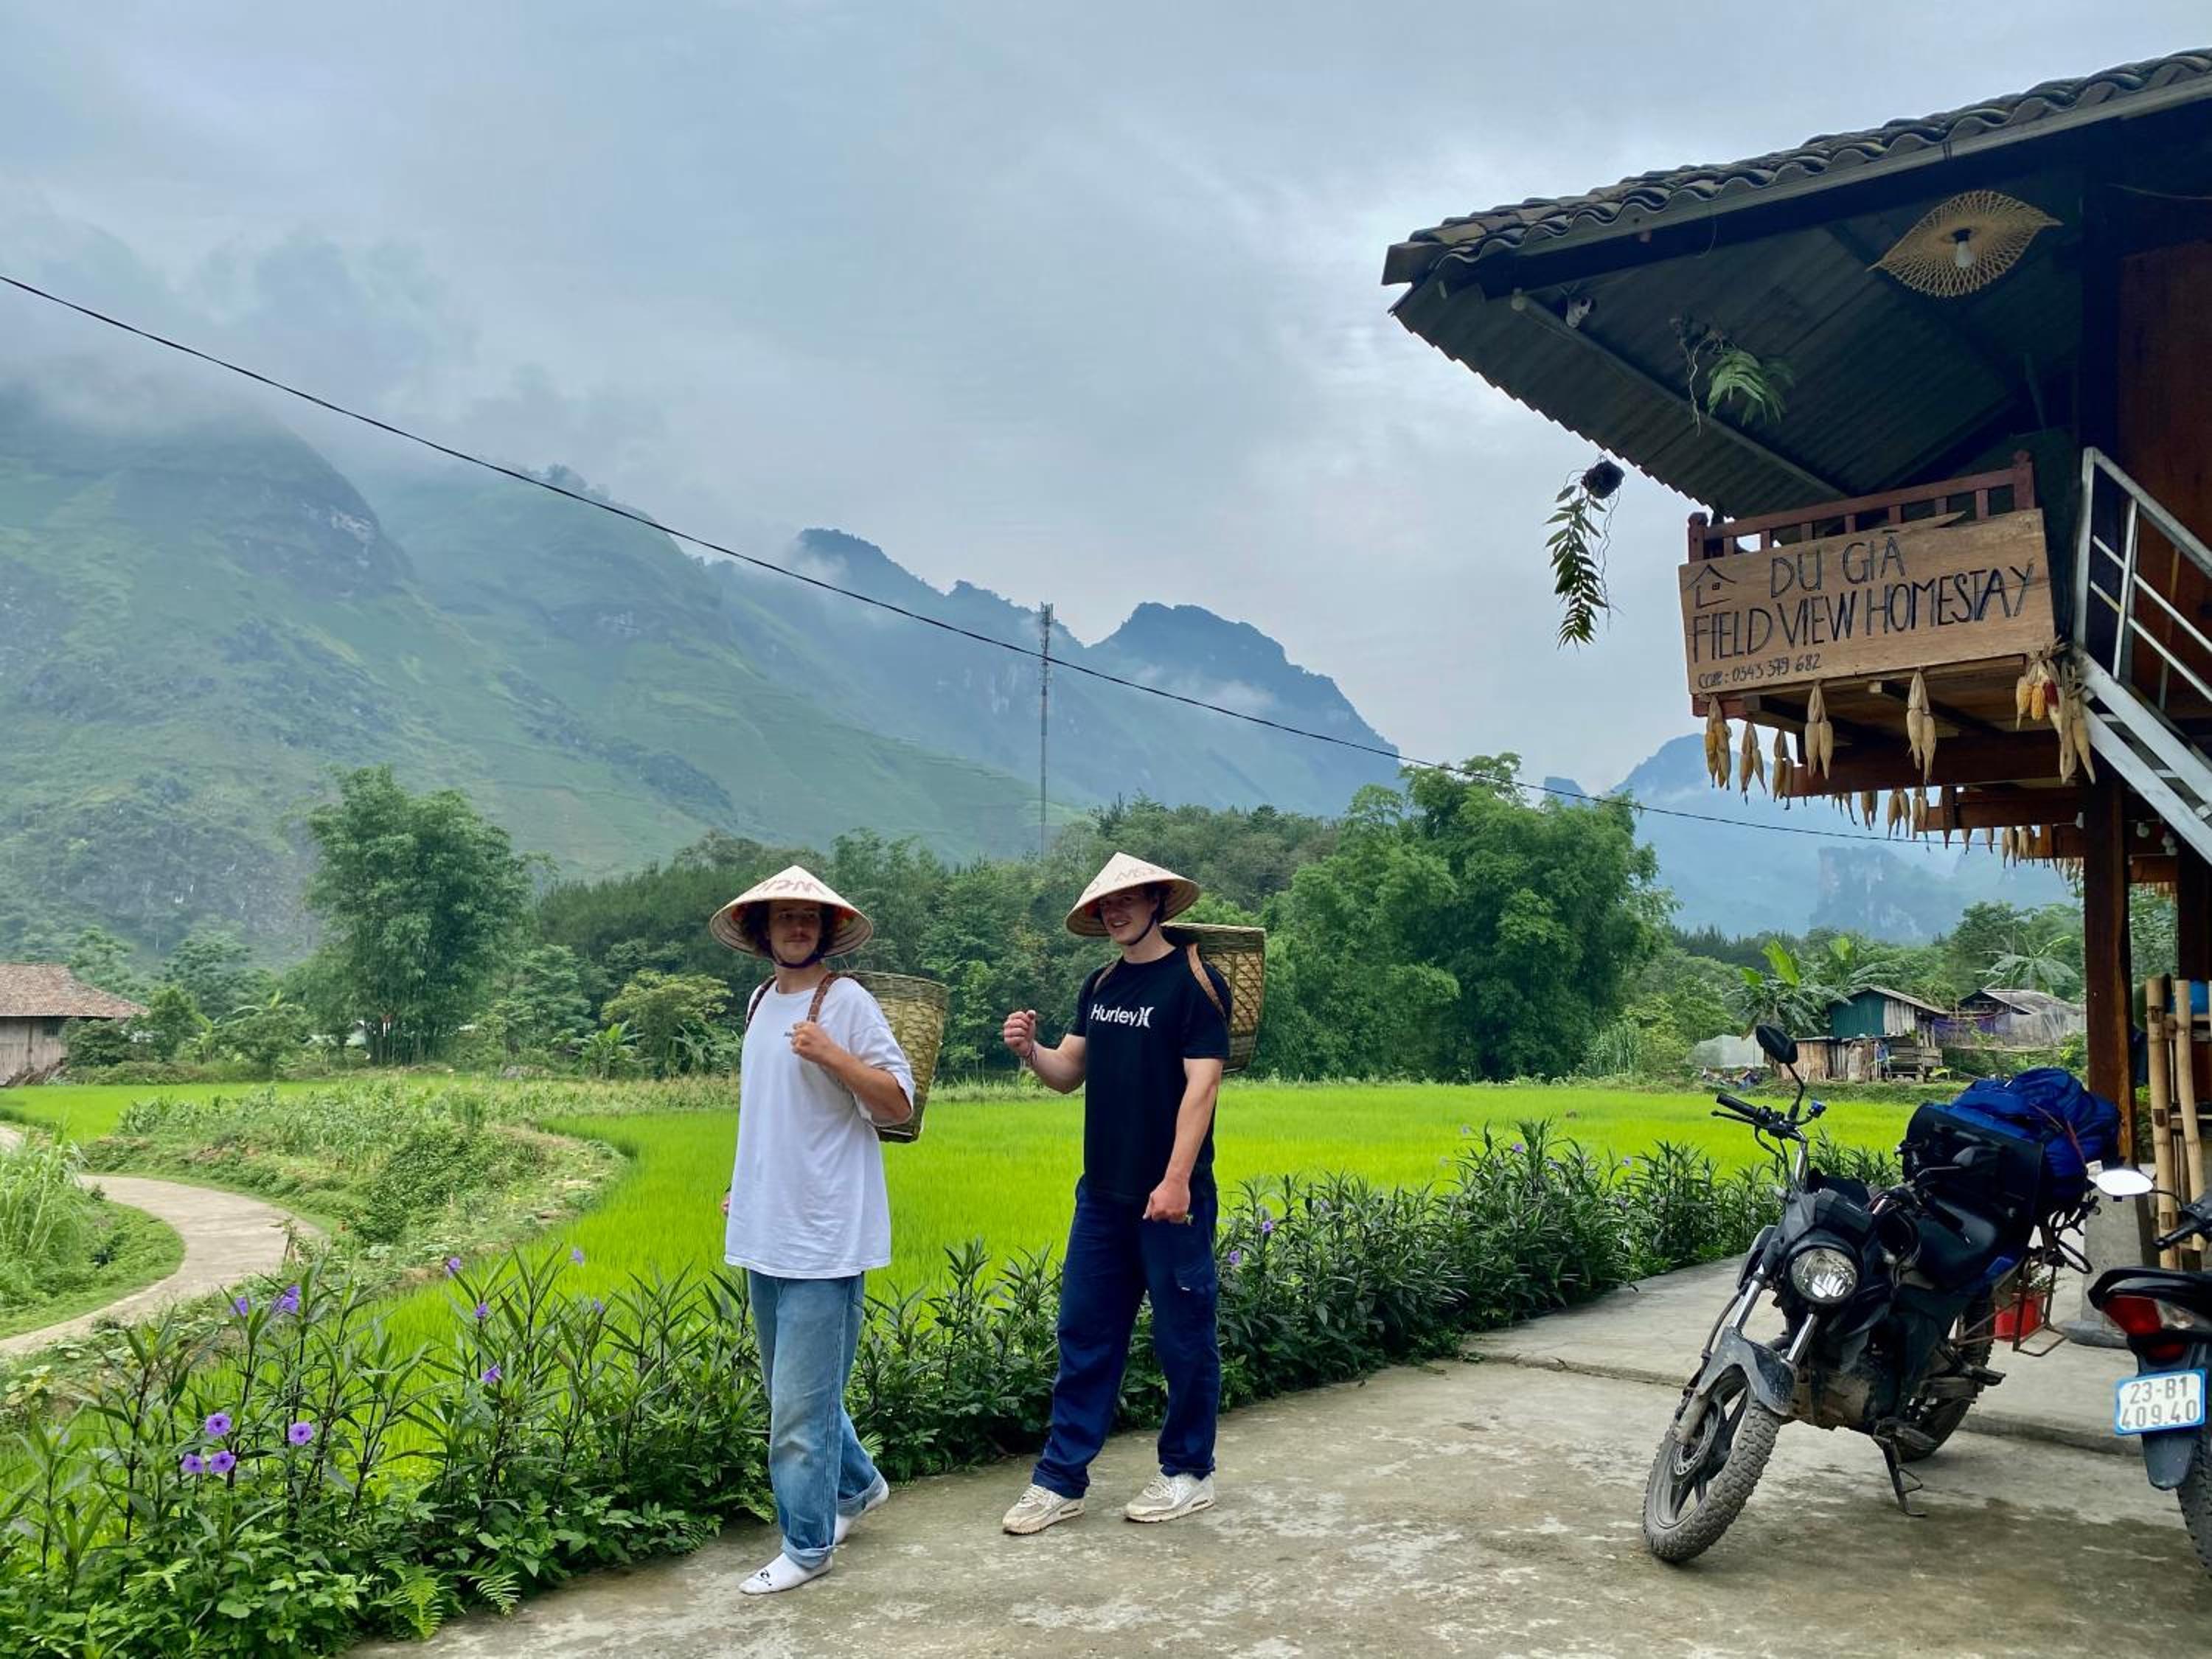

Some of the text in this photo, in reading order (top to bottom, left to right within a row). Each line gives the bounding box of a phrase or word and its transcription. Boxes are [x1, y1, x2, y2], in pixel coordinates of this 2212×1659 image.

[1771, 549, 1822, 598] DU
[1693, 558, 2034, 663] FIELD VIEW HOMESTAY
[1795, 653, 1821, 672] 682
[1090, 1004, 1138, 1026] Hurley
[2129, 1377, 2188, 1405] 23-B1
[2121, 1399, 2197, 1428] 409.40
